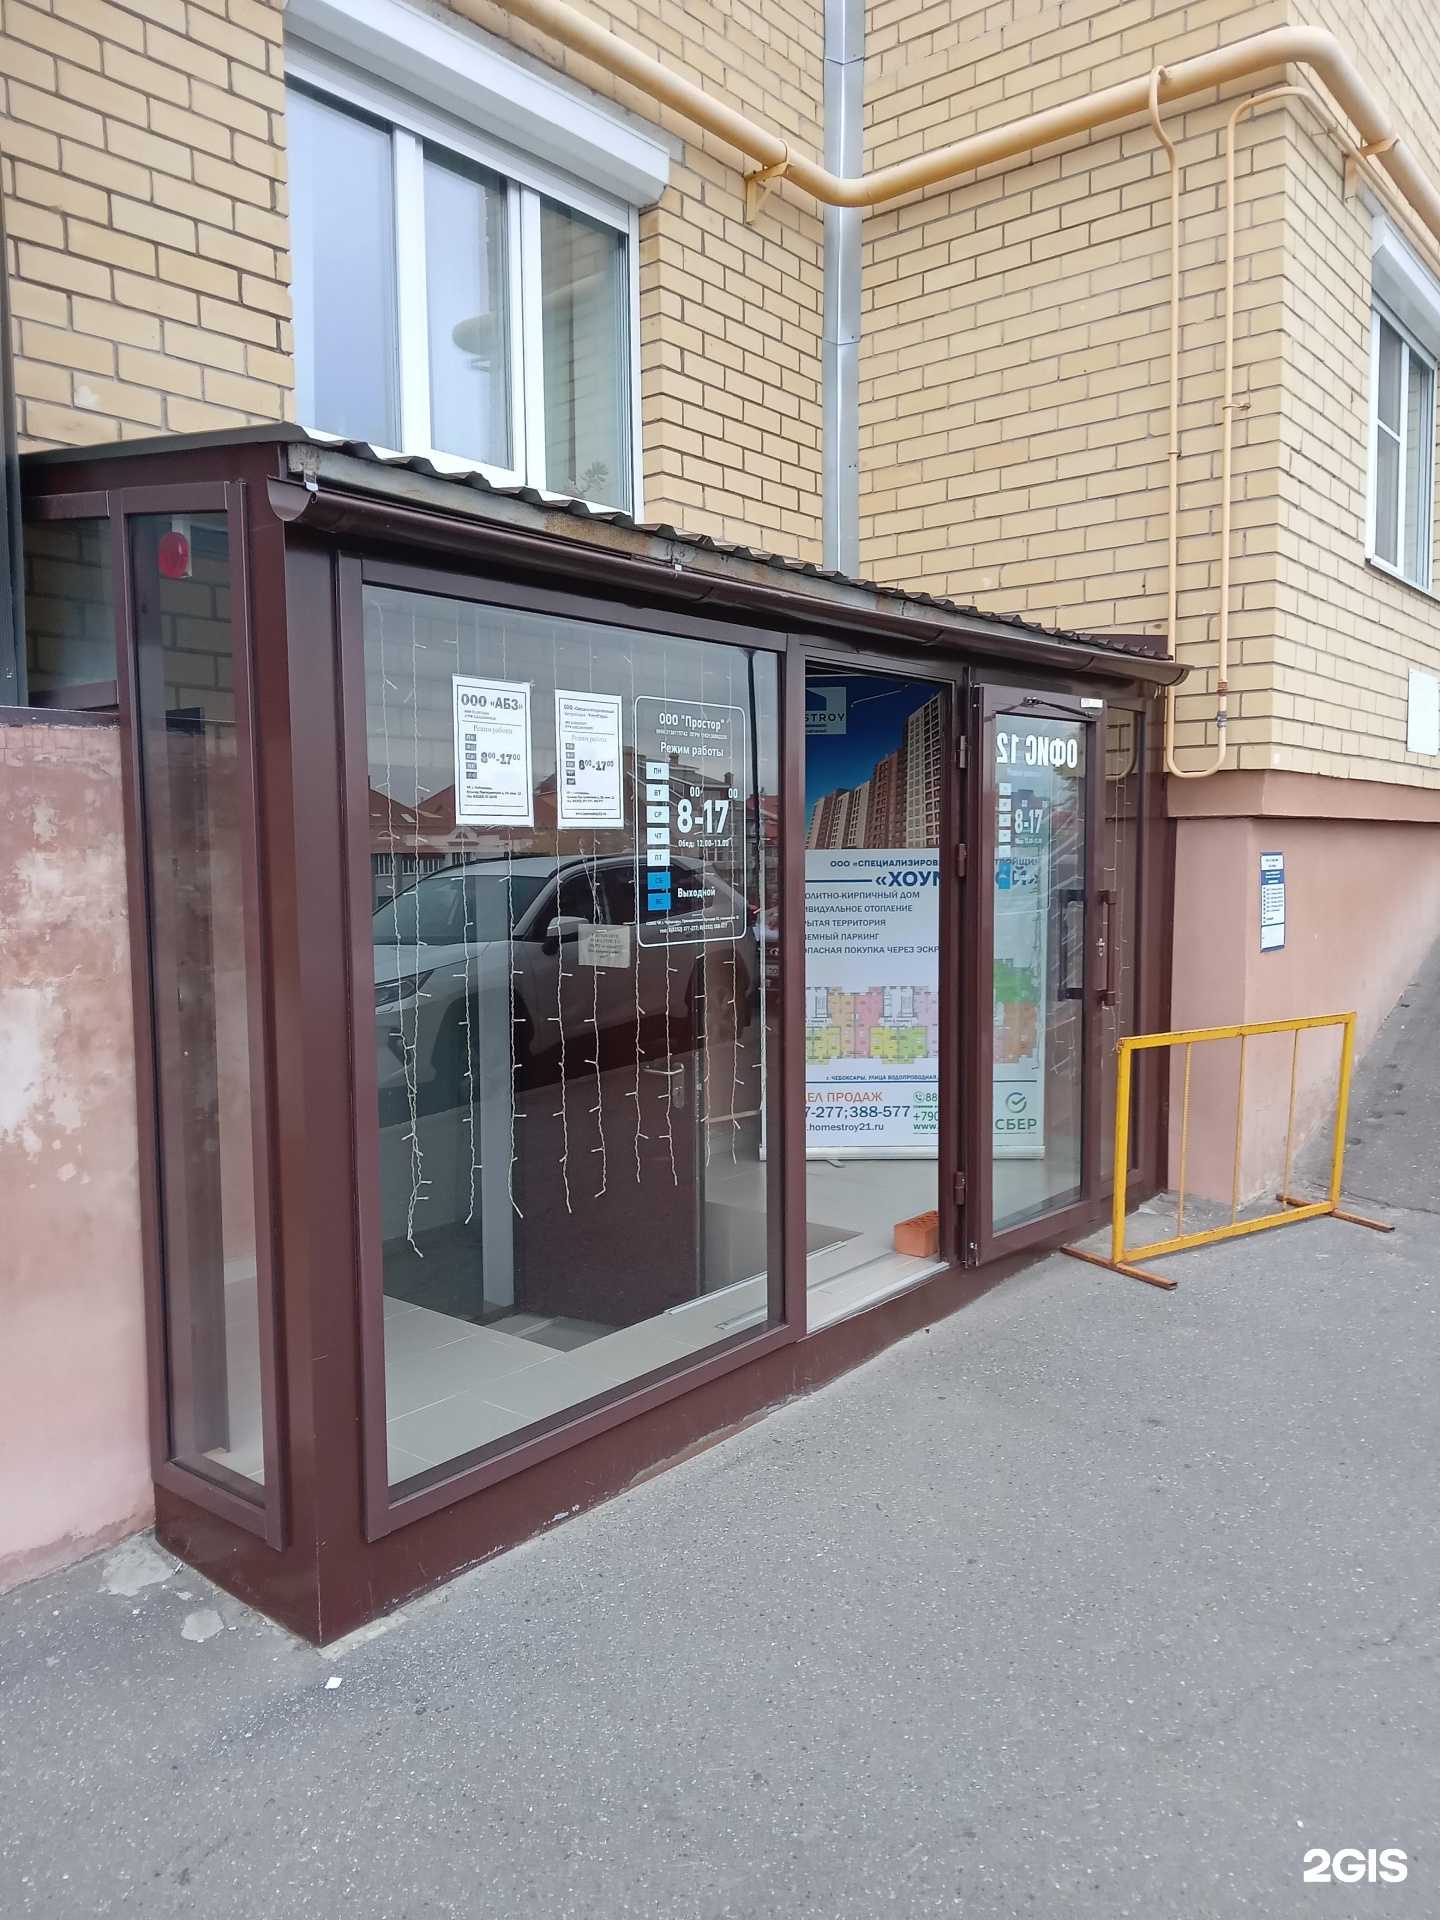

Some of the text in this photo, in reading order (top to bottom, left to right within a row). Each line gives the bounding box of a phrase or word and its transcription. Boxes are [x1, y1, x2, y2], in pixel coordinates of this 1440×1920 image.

[461, 694, 487, 707] ООО
[659, 713, 724, 732] ООО "Простор"
[660, 742, 723, 757] Режим работы
[653, 767, 662, 775] ПН
[677, 887, 716, 898] Выходной
[900, 891, 920, 899] ДОМ
[805, 905, 862, 913] ВИДУАЛЬНОЕ
[832, 919, 886, 927] ТЕРРИТОРИЯ
[841, 933, 879, 941] ПАРКИНГ
[844, 946, 885, 954] ПОКУПКА
[827, 1092, 882, 1103] ПРОДАЖ
[995, 1118, 1037, 1130] СБЕР
